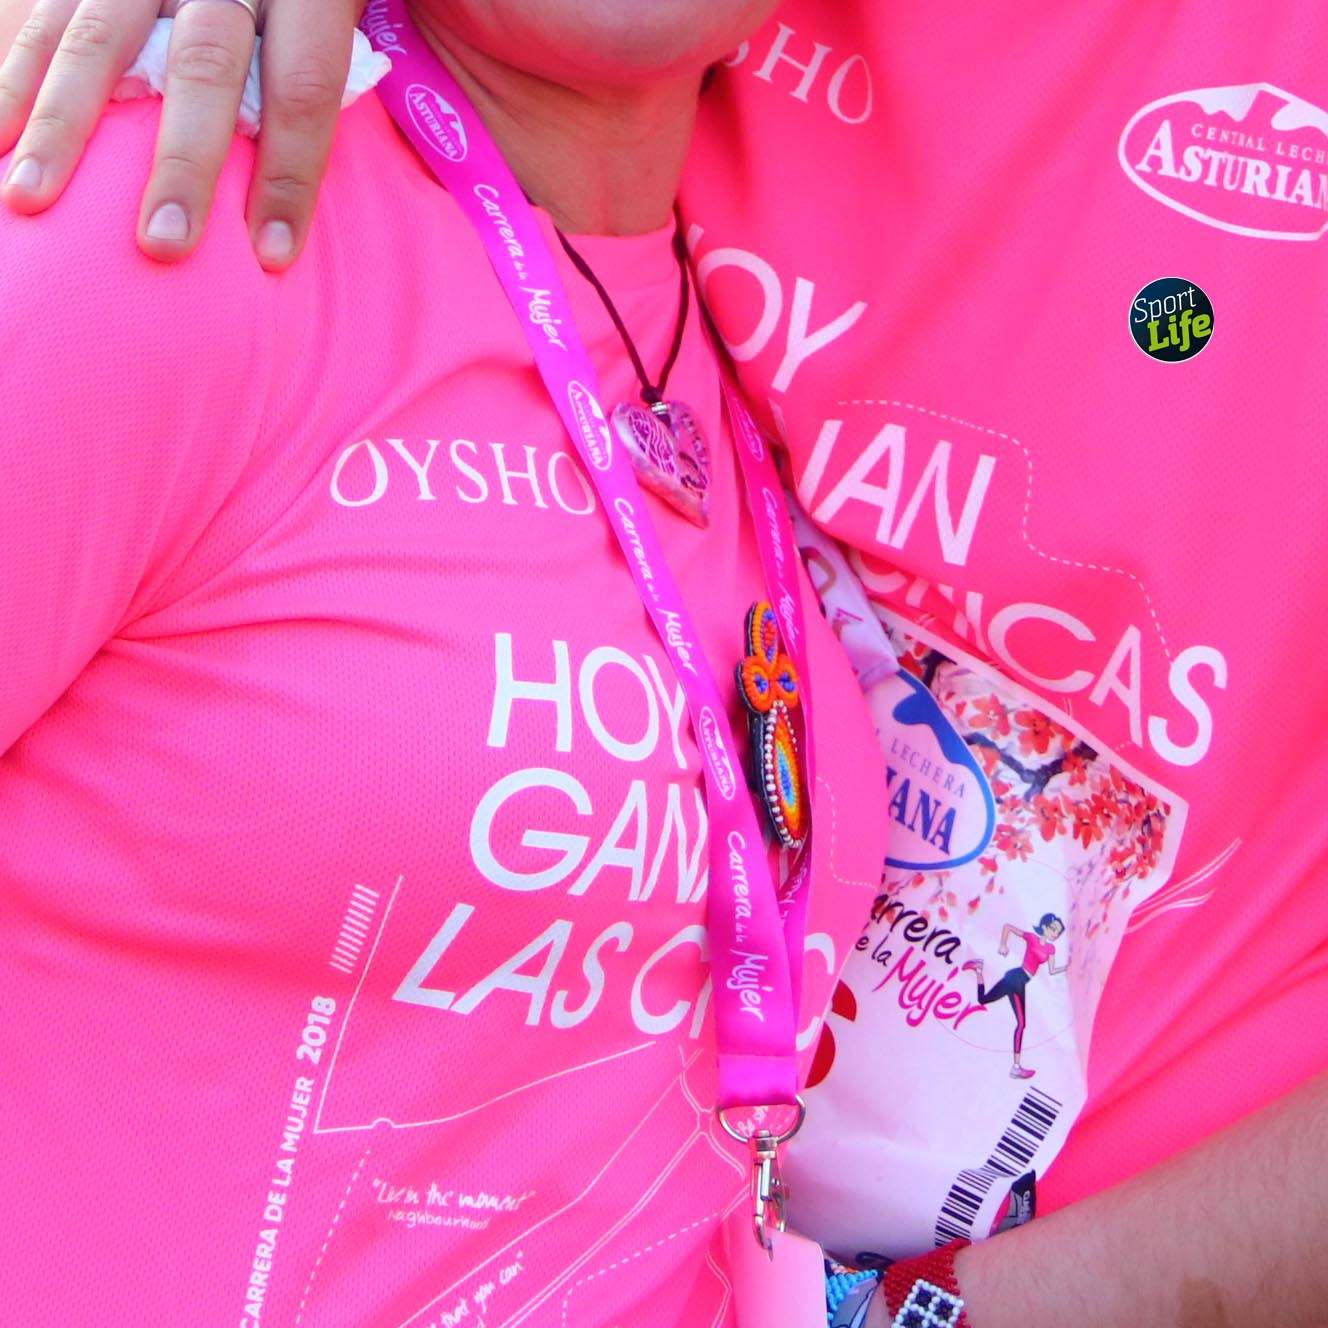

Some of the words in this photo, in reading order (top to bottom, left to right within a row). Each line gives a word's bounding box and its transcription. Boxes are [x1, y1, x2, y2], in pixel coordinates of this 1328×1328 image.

[473, 184, 524, 259] Carrera
[520, 286, 568, 352] Mujer
[1134, 286, 1197, 323] Sport
[686, 225, 867, 394] OY
[1147, 310, 1212, 352] Life
[330, 438, 596, 515] OYSHO
[614, 497, 653, 581] Carrera
[656, 607, 698, 677] Mujer
[486, 632, 688, 769] HOY
[889, 737, 966, 799] LECHERA
[727, 831, 753, 920] Carrera
[392, 903, 634, 1029] LAS
[726, 948, 774, 1023] Mujer
[872, 934, 892, 967] la
[872, 946, 988, 1030] Mujer
[296, 996, 336, 1064] 2018
[280, 1076, 314, 1152] MUJER
[264, 1190, 287, 1223] DE
[272, 1159, 295, 1187] LA
[240, 1229, 278, 1328] CARRERA
